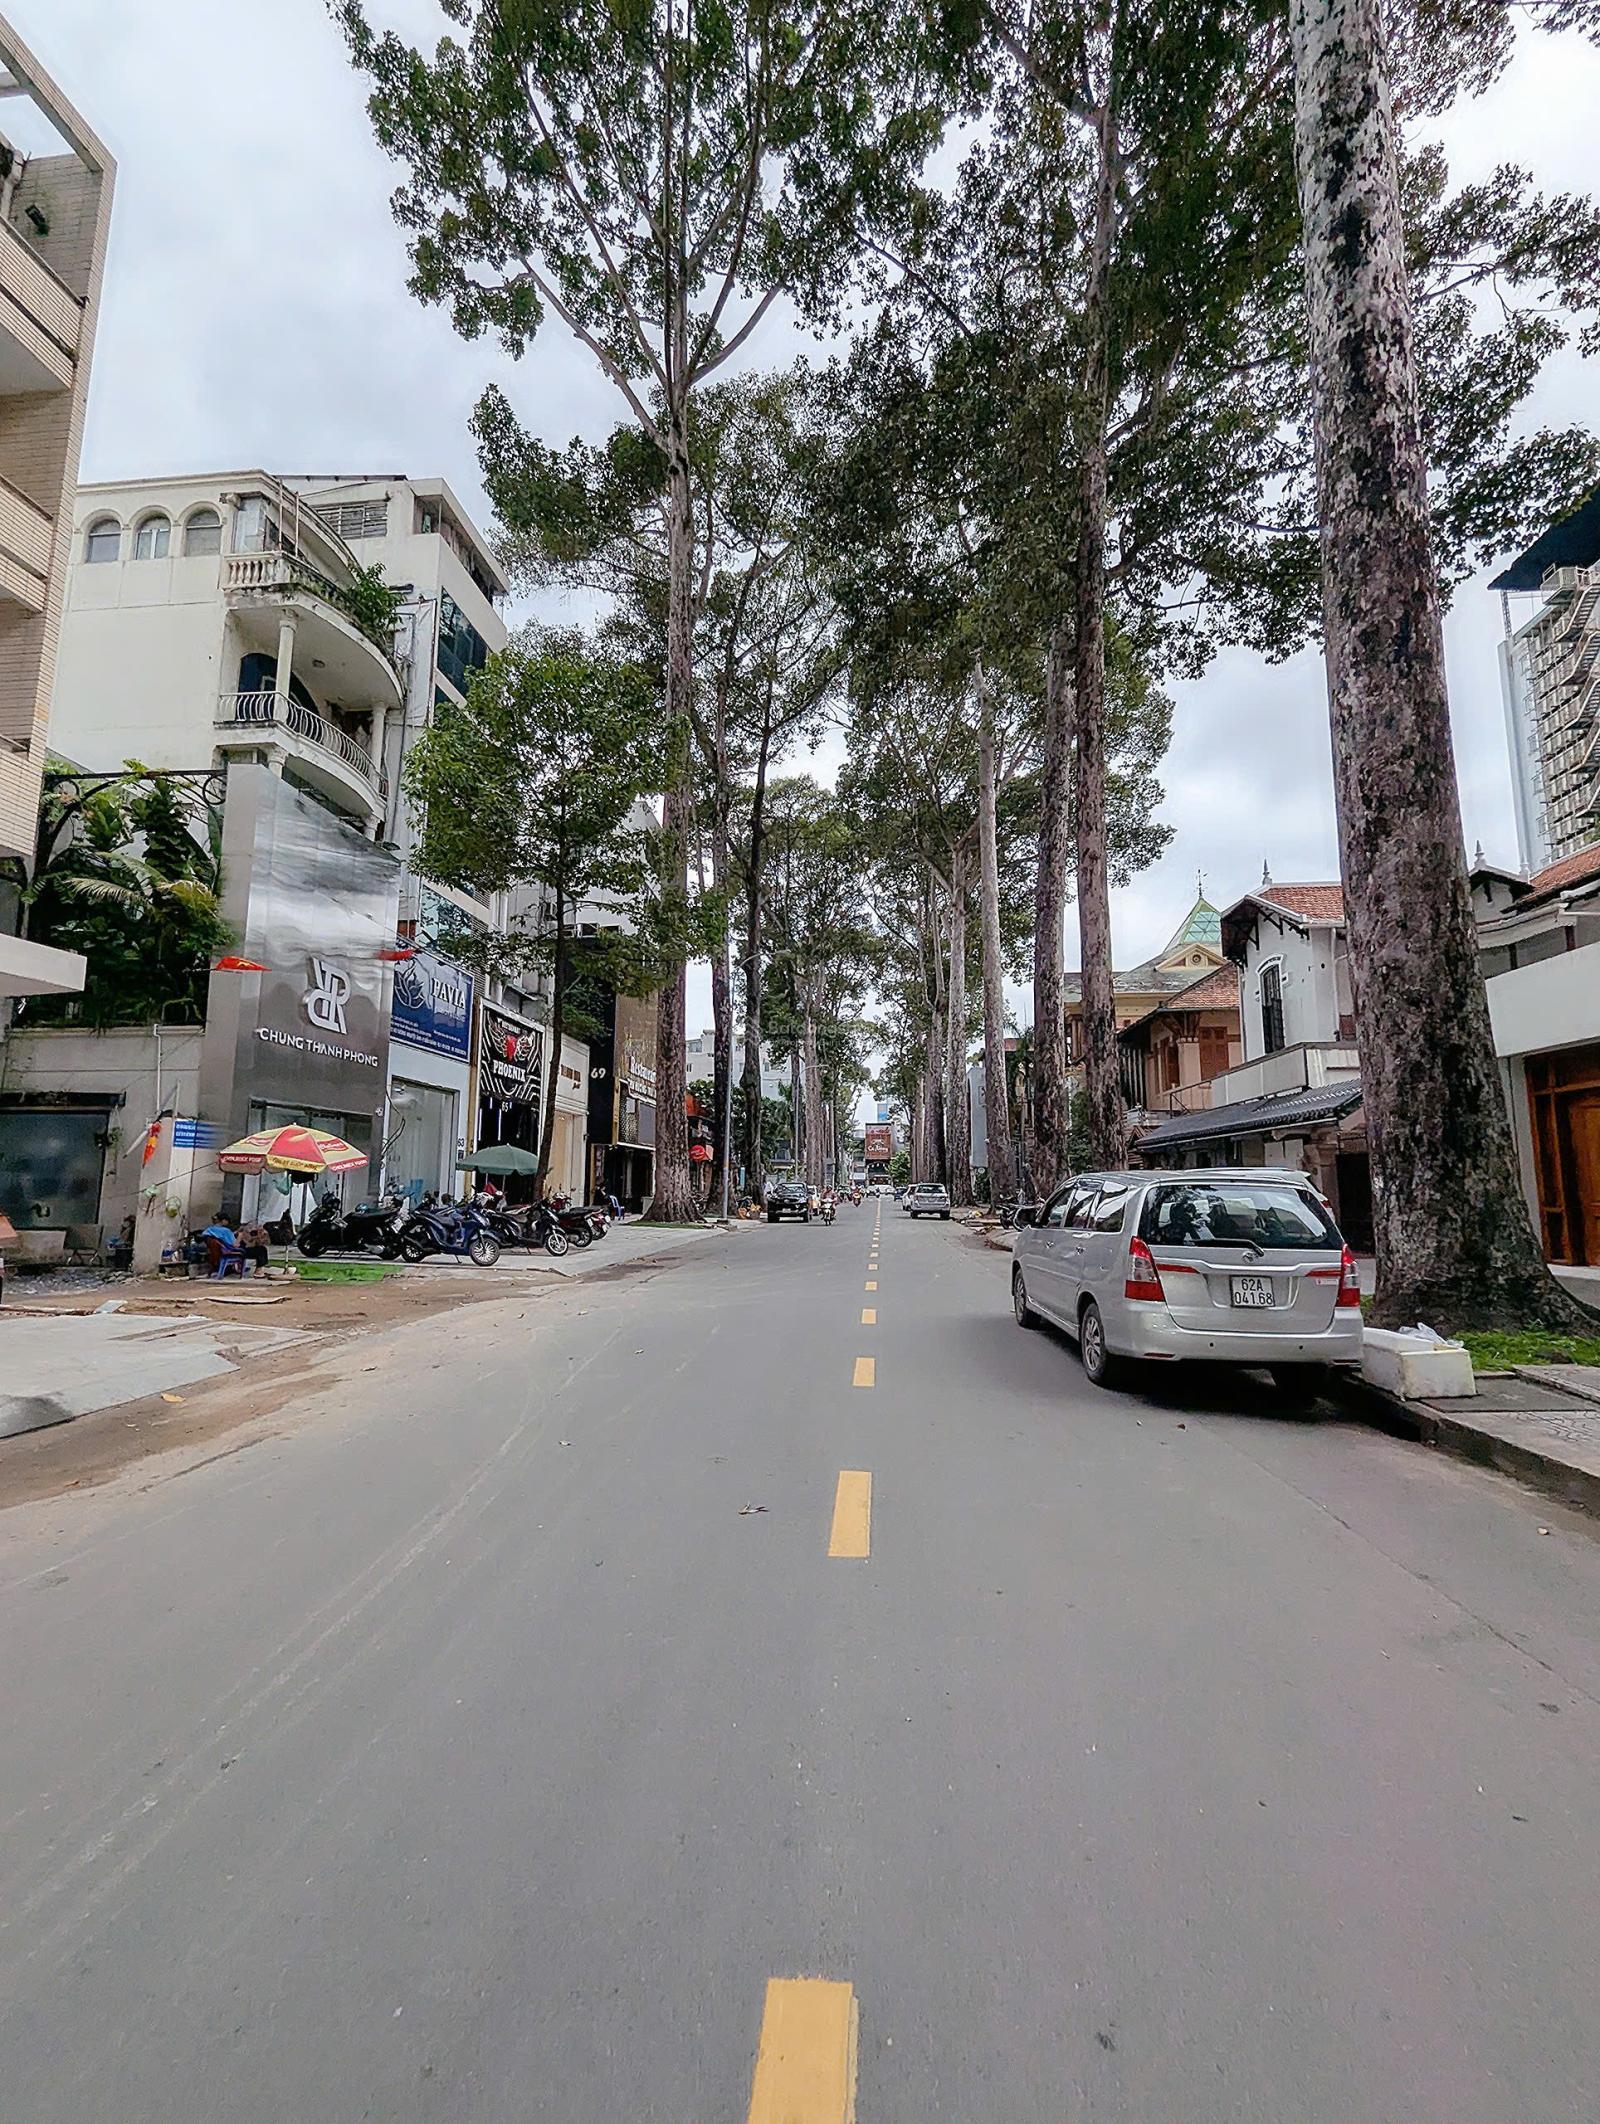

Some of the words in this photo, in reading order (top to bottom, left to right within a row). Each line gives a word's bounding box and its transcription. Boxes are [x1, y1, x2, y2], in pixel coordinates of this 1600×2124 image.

[432, 978, 465, 1009] PAVIA
[259, 1028, 304, 1050] CHUNG
[306, 1039, 343, 1059] THANH
[344, 1050, 378, 1067] PHONG
[493, 1060, 526, 1082] PHOENIX
[590, 1067, 606, 1079] 69
[1241, 1279, 1264, 1292] 62A
[1234, 1291, 1273, 1305] 041.68
